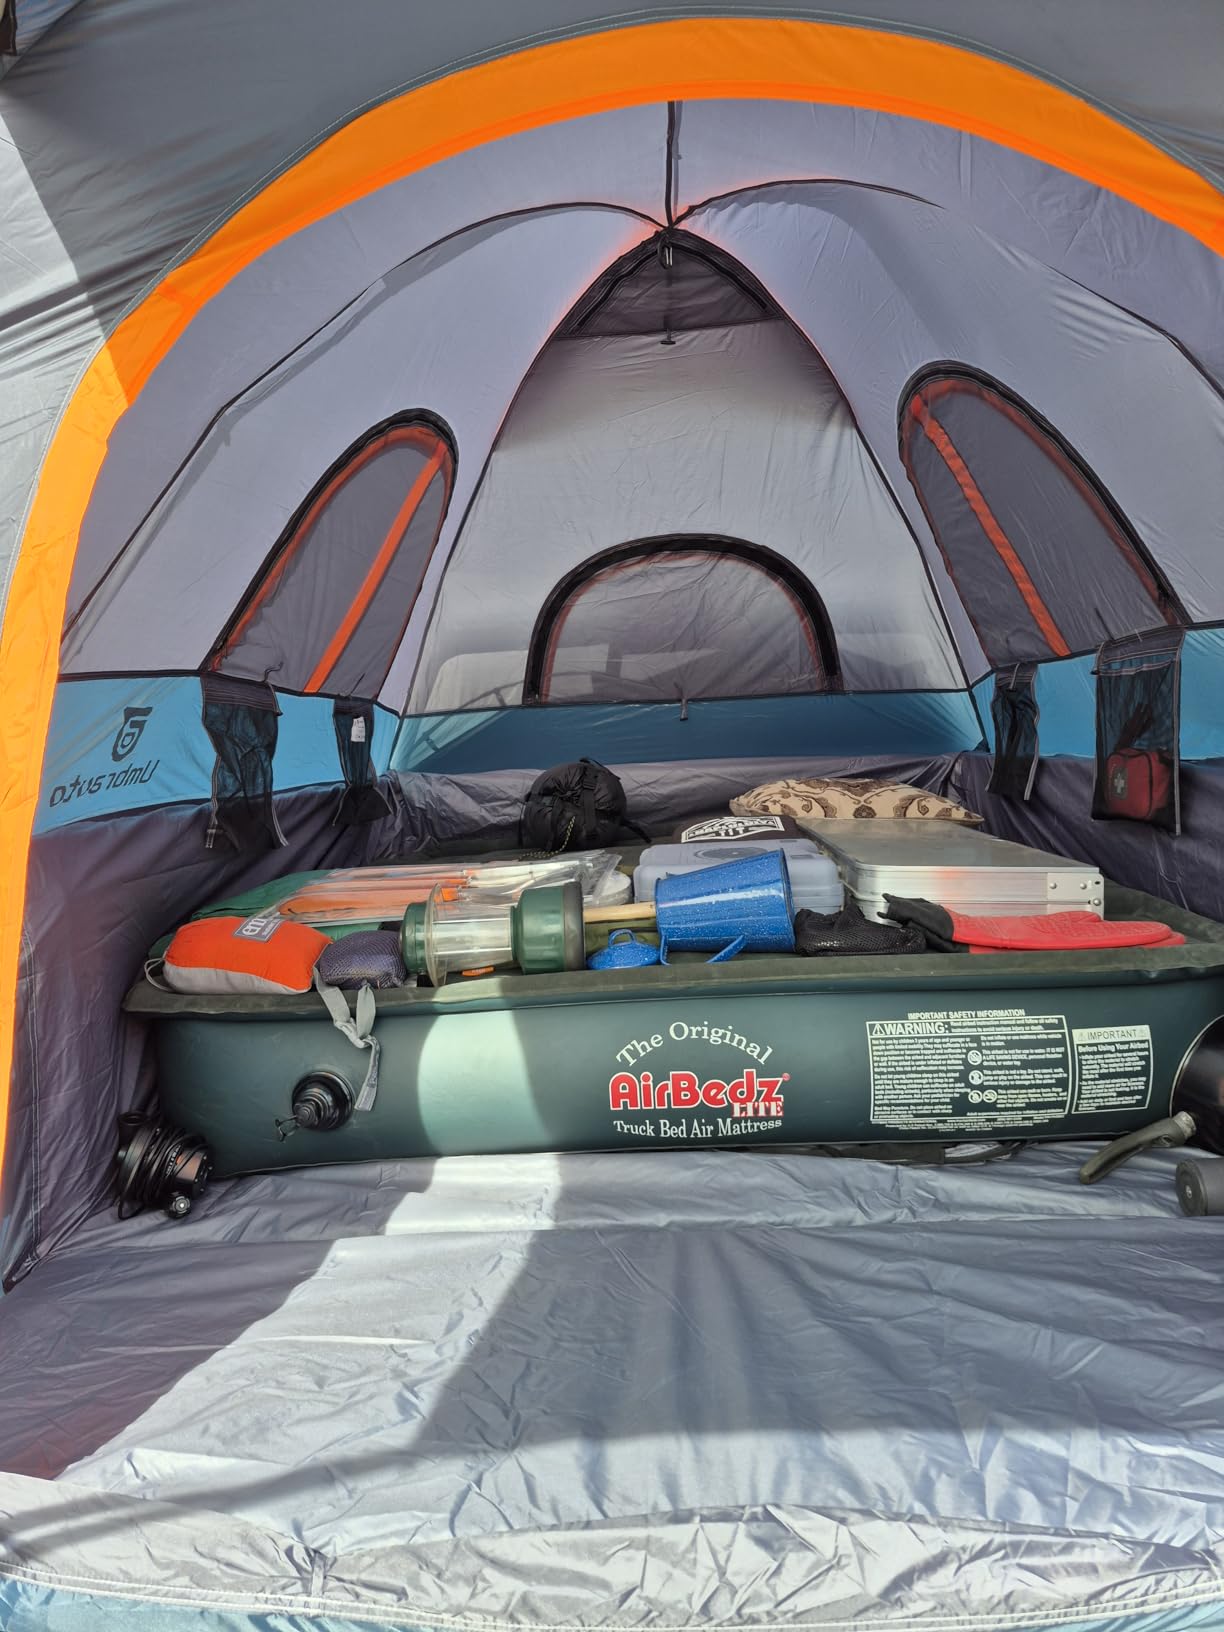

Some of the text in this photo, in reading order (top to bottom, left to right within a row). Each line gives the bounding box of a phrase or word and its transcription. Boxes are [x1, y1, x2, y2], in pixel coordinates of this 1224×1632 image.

[907, 1008, 1025, 1020] IMPORTANT SAFETY INFORMATION
[883, 1021, 949, 1035] WARNING:
[1087, 1029, 1137, 1041] IMPORTANT
[615, 1020, 773, 1067] The Original
[609, 1068, 785, 1110] AirBedz
[731, 1101, 784, 1117] LITE
[613, 1117, 782, 1138] Truck Bed Air Mattress
